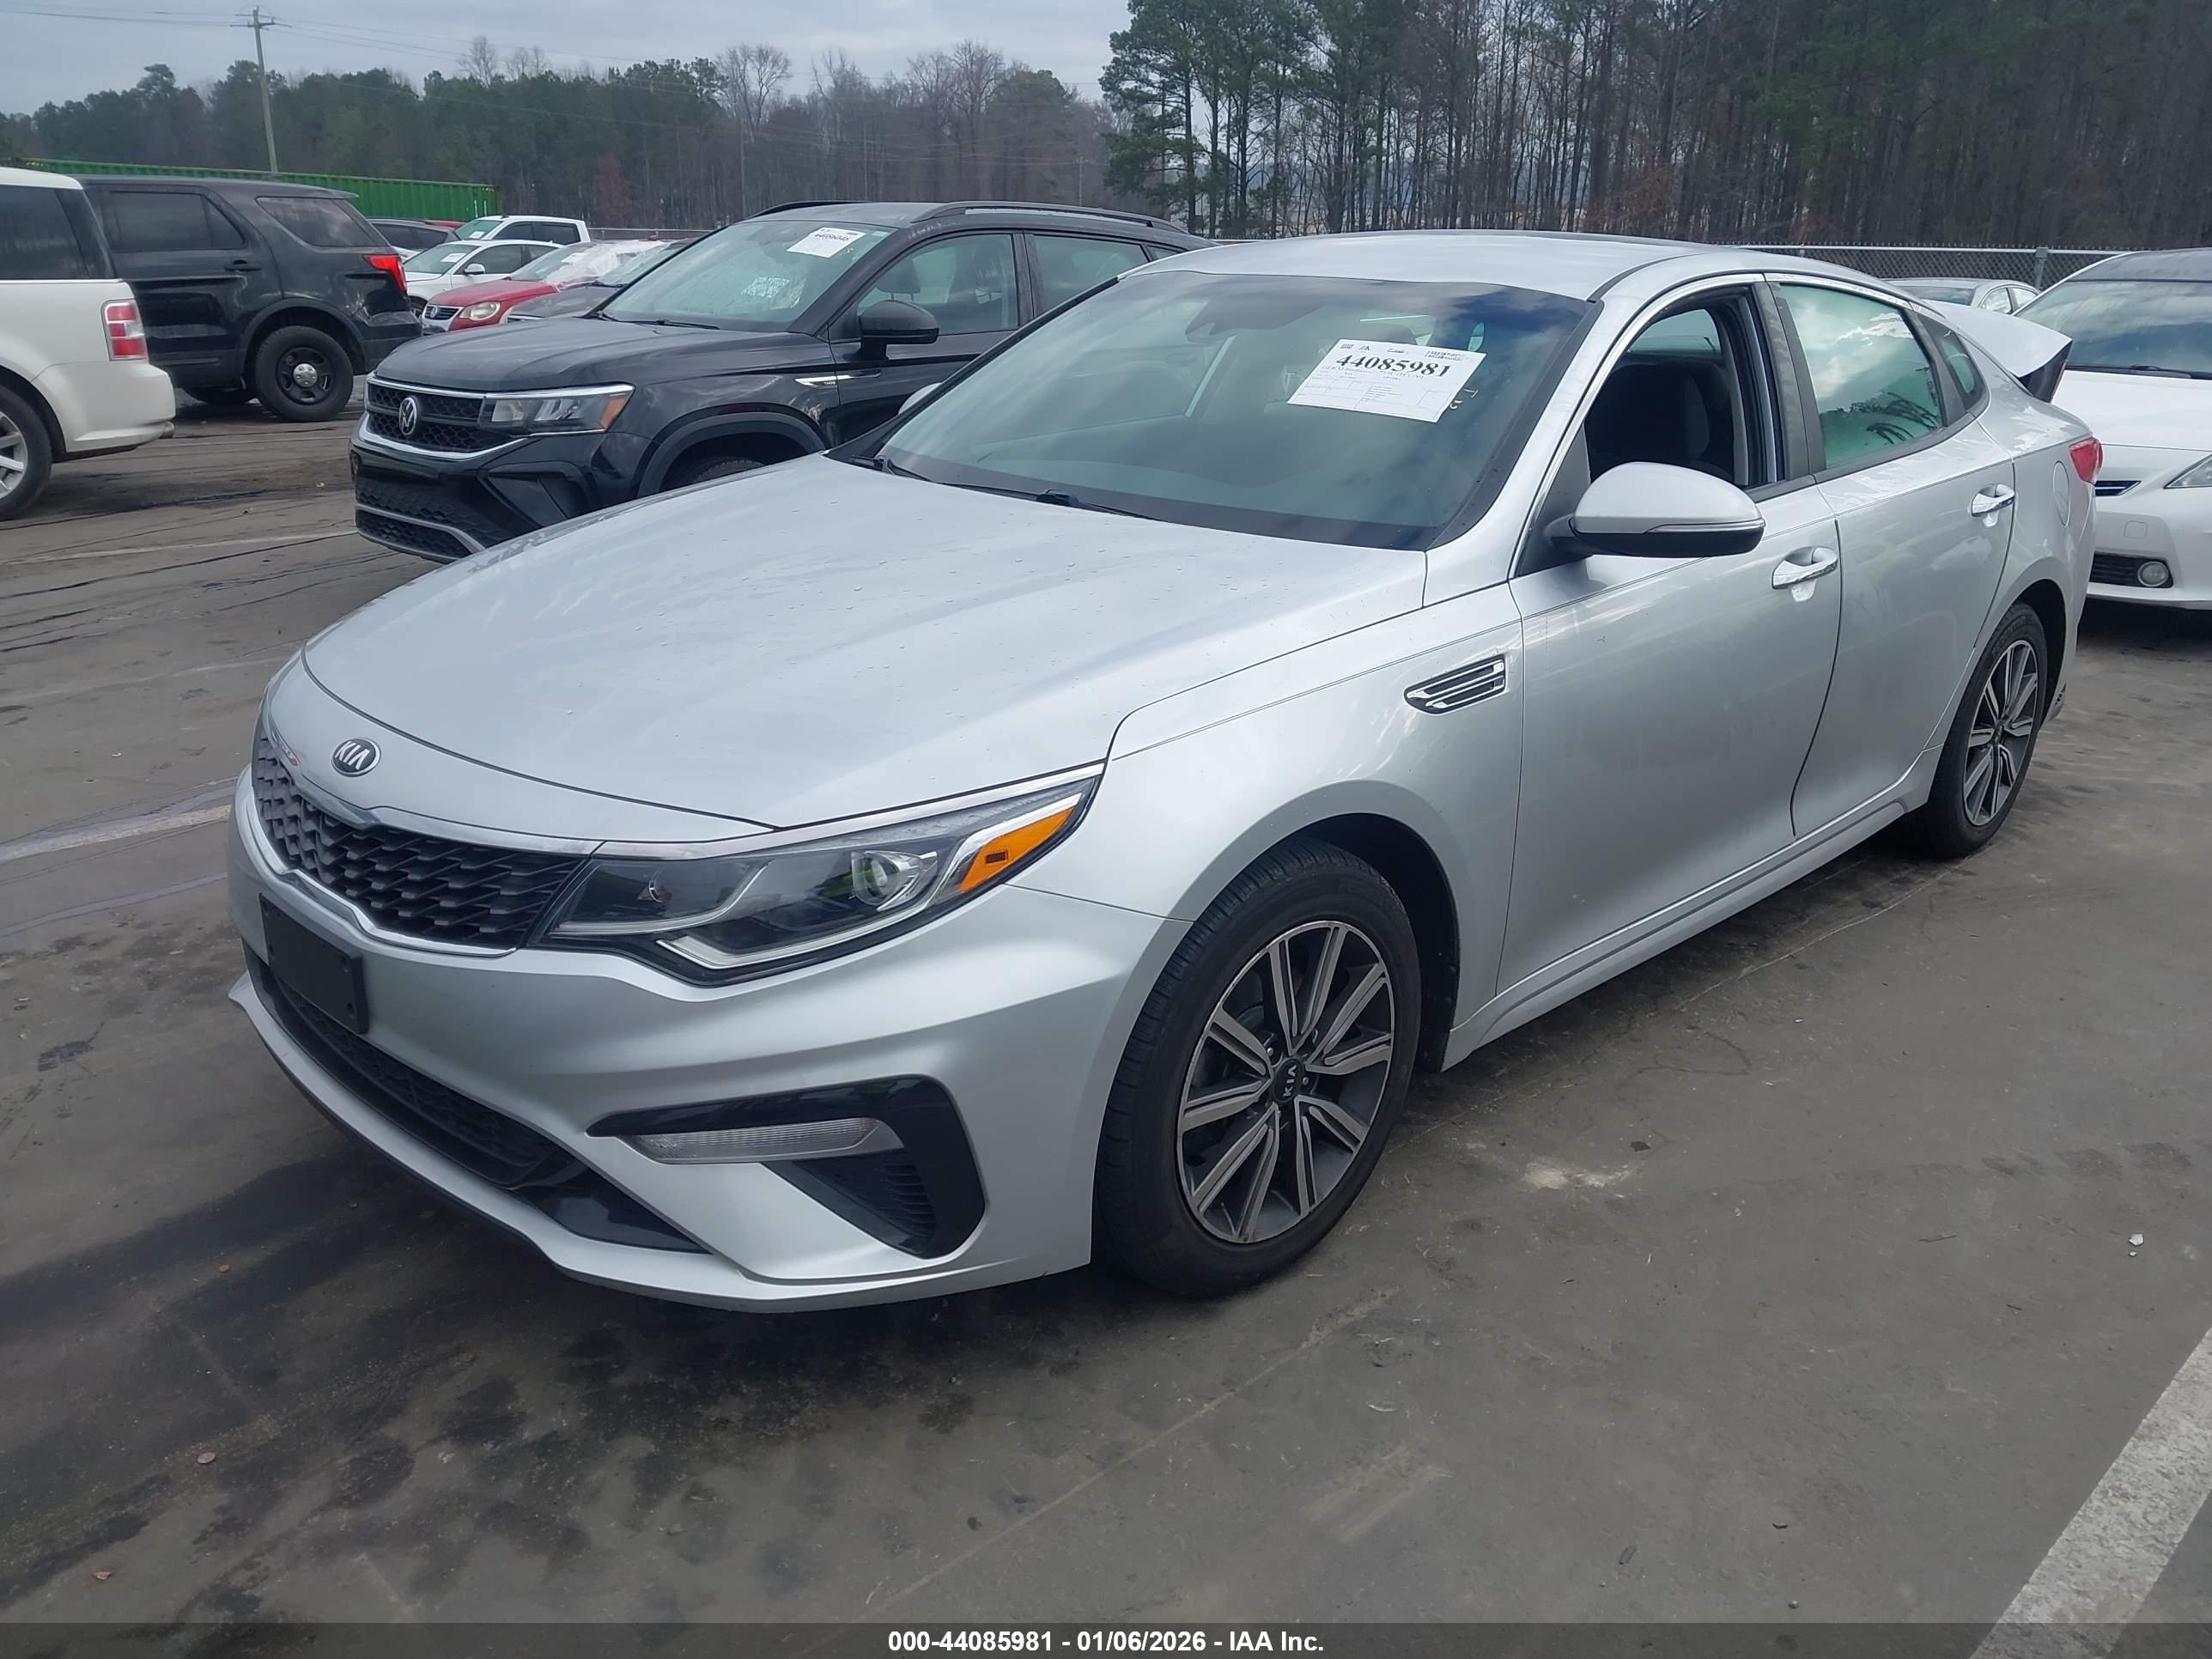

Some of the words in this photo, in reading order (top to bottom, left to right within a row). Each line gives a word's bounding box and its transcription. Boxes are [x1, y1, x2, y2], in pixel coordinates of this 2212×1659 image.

[1336, 355, 1451, 377] 44085981
[334, 741, 370, 770] KIA
[1283, 1065, 1297, 1097] KIA
